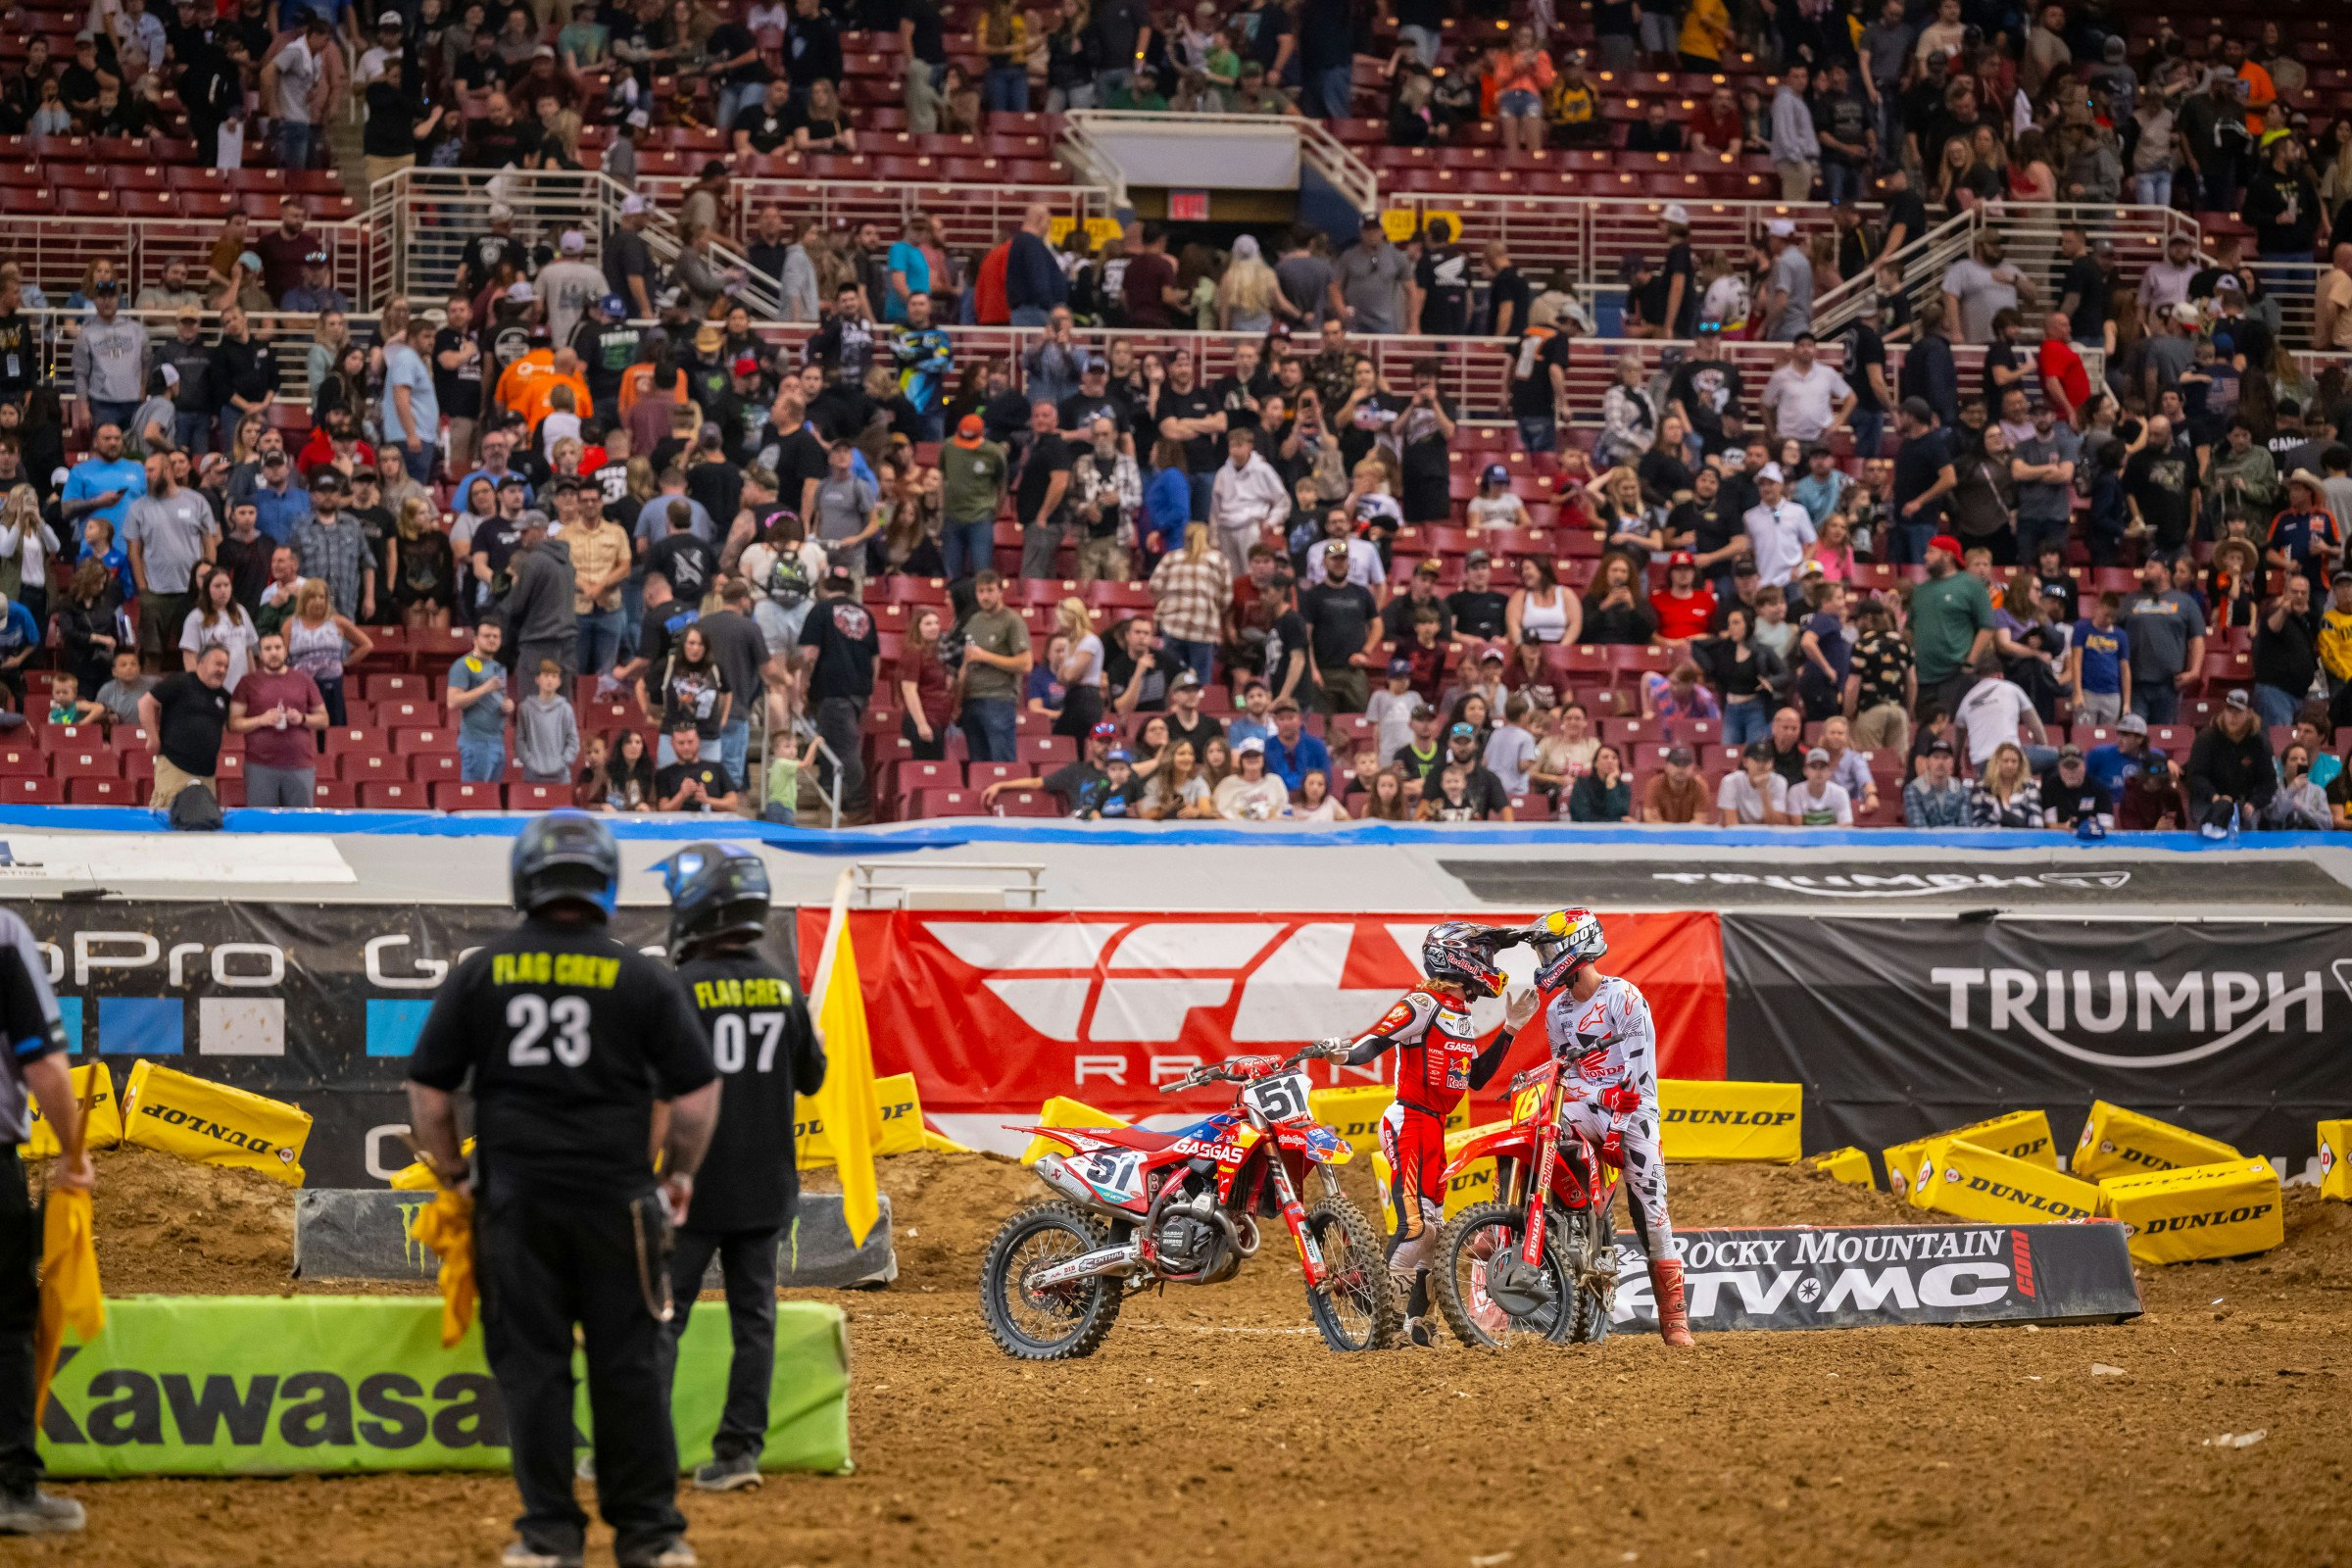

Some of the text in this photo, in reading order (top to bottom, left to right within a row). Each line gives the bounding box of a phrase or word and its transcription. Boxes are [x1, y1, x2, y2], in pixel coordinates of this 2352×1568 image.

[1653, 872, 2043, 893] TRIUMPH
[36, 932, 285, 988] Pro
[493, 954, 551, 986] FLAG
[555, 954, 620, 989] CREW
[695, 978, 793, 1009] FLAG CREW
[1932, 967, 2323, 1058] TRIUMPH
[507, 994, 591, 1067] 23
[713, 1012, 784, 1073] 07
[1254, 1077, 1306, 1120] 51
[1512, 1083, 1547, 1126] 18
[1663, 1108, 1795, 1126] DUNLOP
[141, 1103, 272, 1154] DUNLOP
[1087, 1146, 1139, 1192] 51
[1172, 1138, 1245, 1164] GASGAS
[1541, 1145, 1556, 1190] SHOWA
[2120, 1147, 2182, 1171] DUN
[1965, 1176, 2090, 1220] DUNLOP
[2142, 1203, 2273, 1236] DUNLOP
[1529, 1209, 1542, 1258] DUNLOP
[1670, 1229, 2005, 1269] ROCKY MOUNTAIN
[37, 1346, 513, 1448] Kawasa
